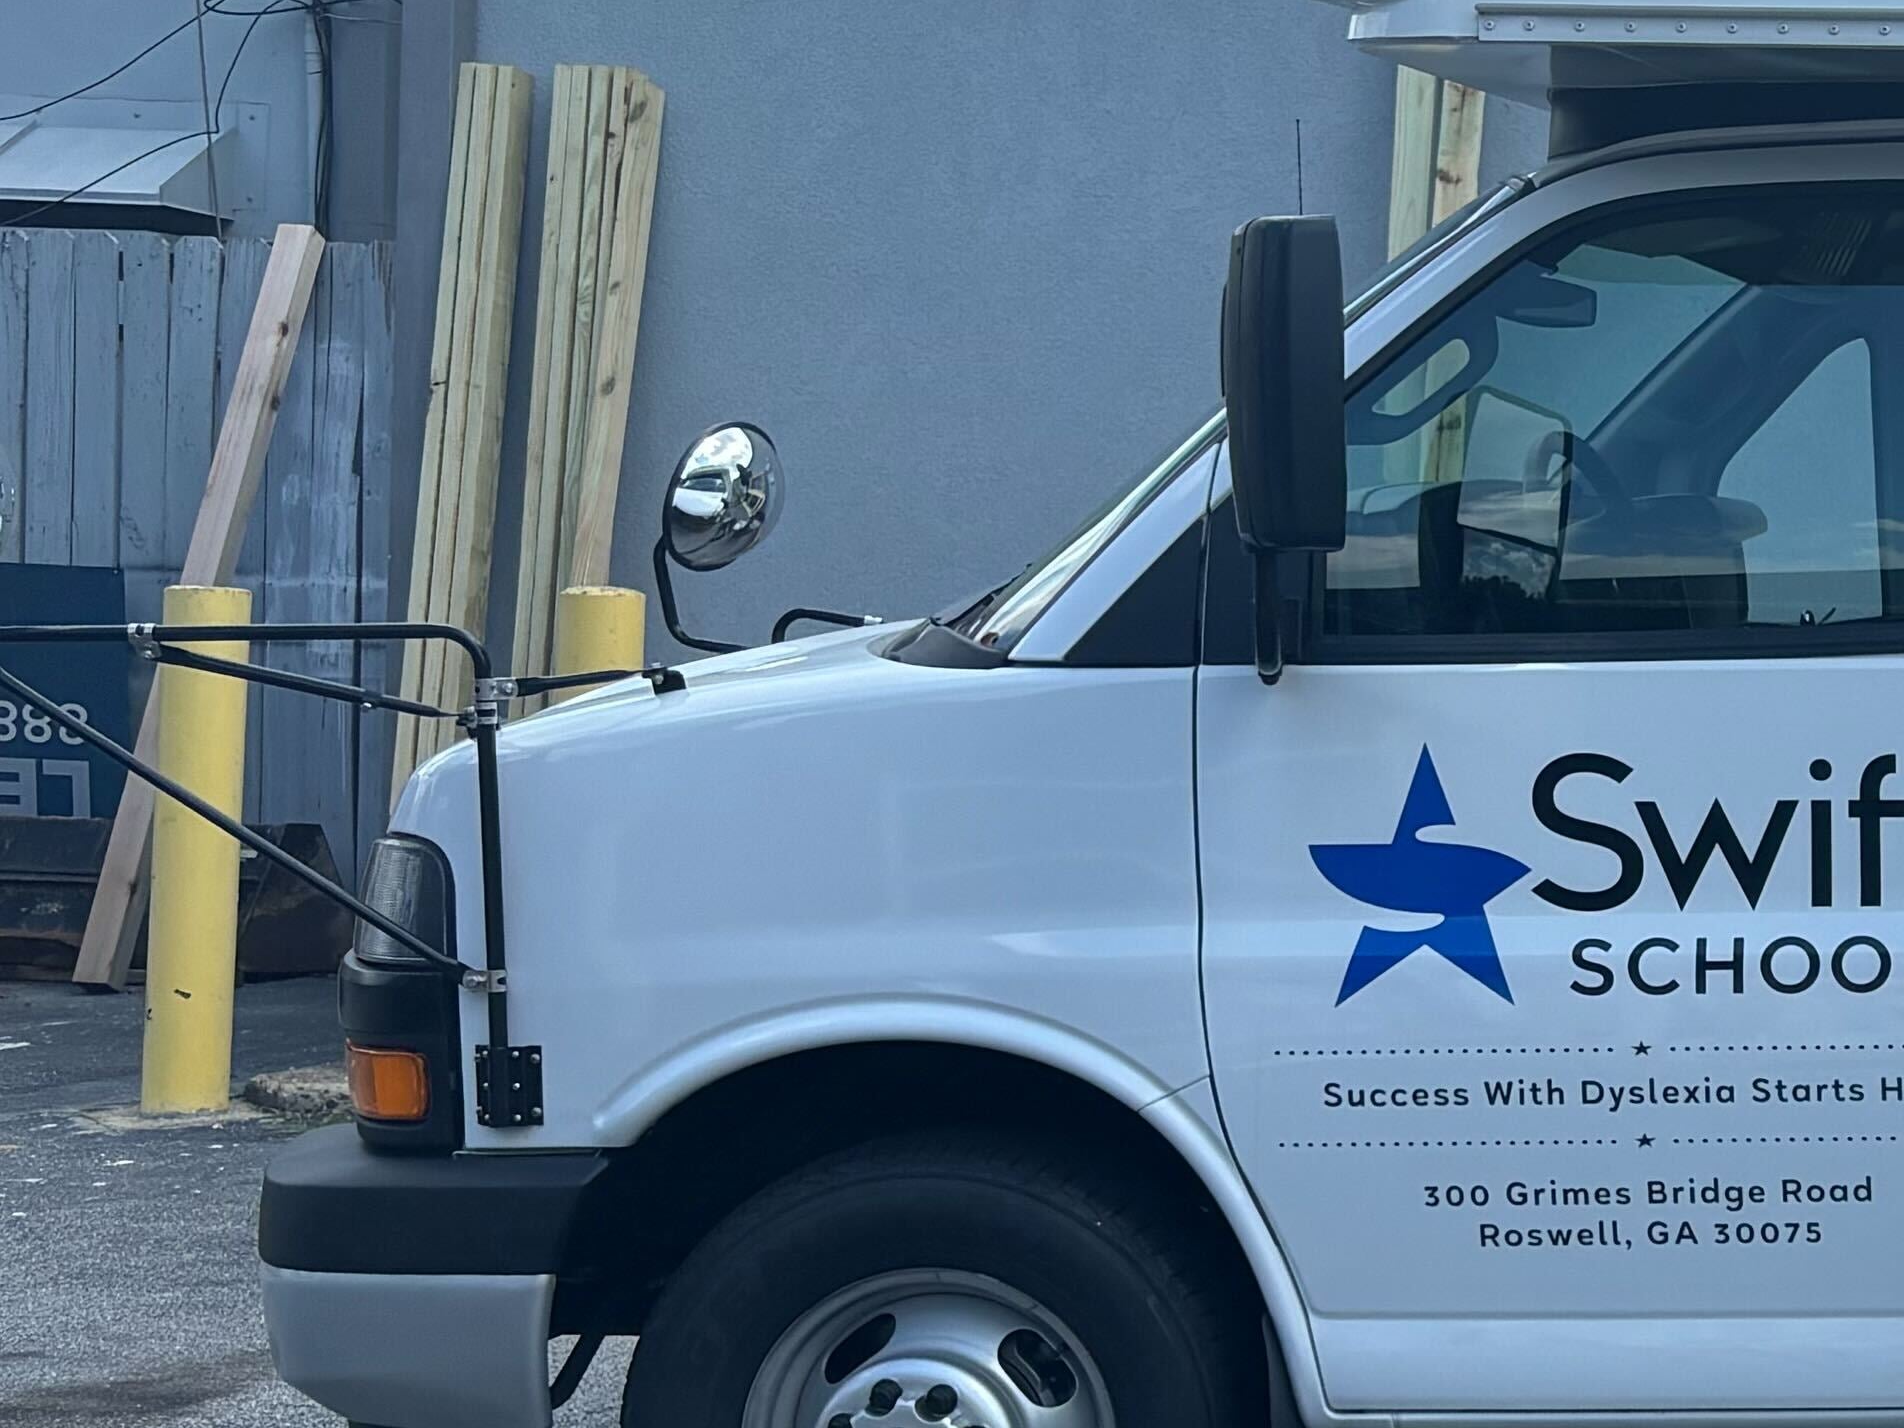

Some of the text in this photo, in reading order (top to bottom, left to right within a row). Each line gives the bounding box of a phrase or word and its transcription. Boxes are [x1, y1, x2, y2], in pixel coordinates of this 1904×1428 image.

[1323, 1082, 1470, 1110] Success
[1483, 1078, 1567, 1107] With
[1581, 1076, 1737, 1115] Dyslexia
[1751, 1077, 1867, 1105] Starts
[1423, 1175, 1874, 1214] 300 Grimes Bridge Road
[1479, 1220, 1824, 1251] Roswell, GA 30075
